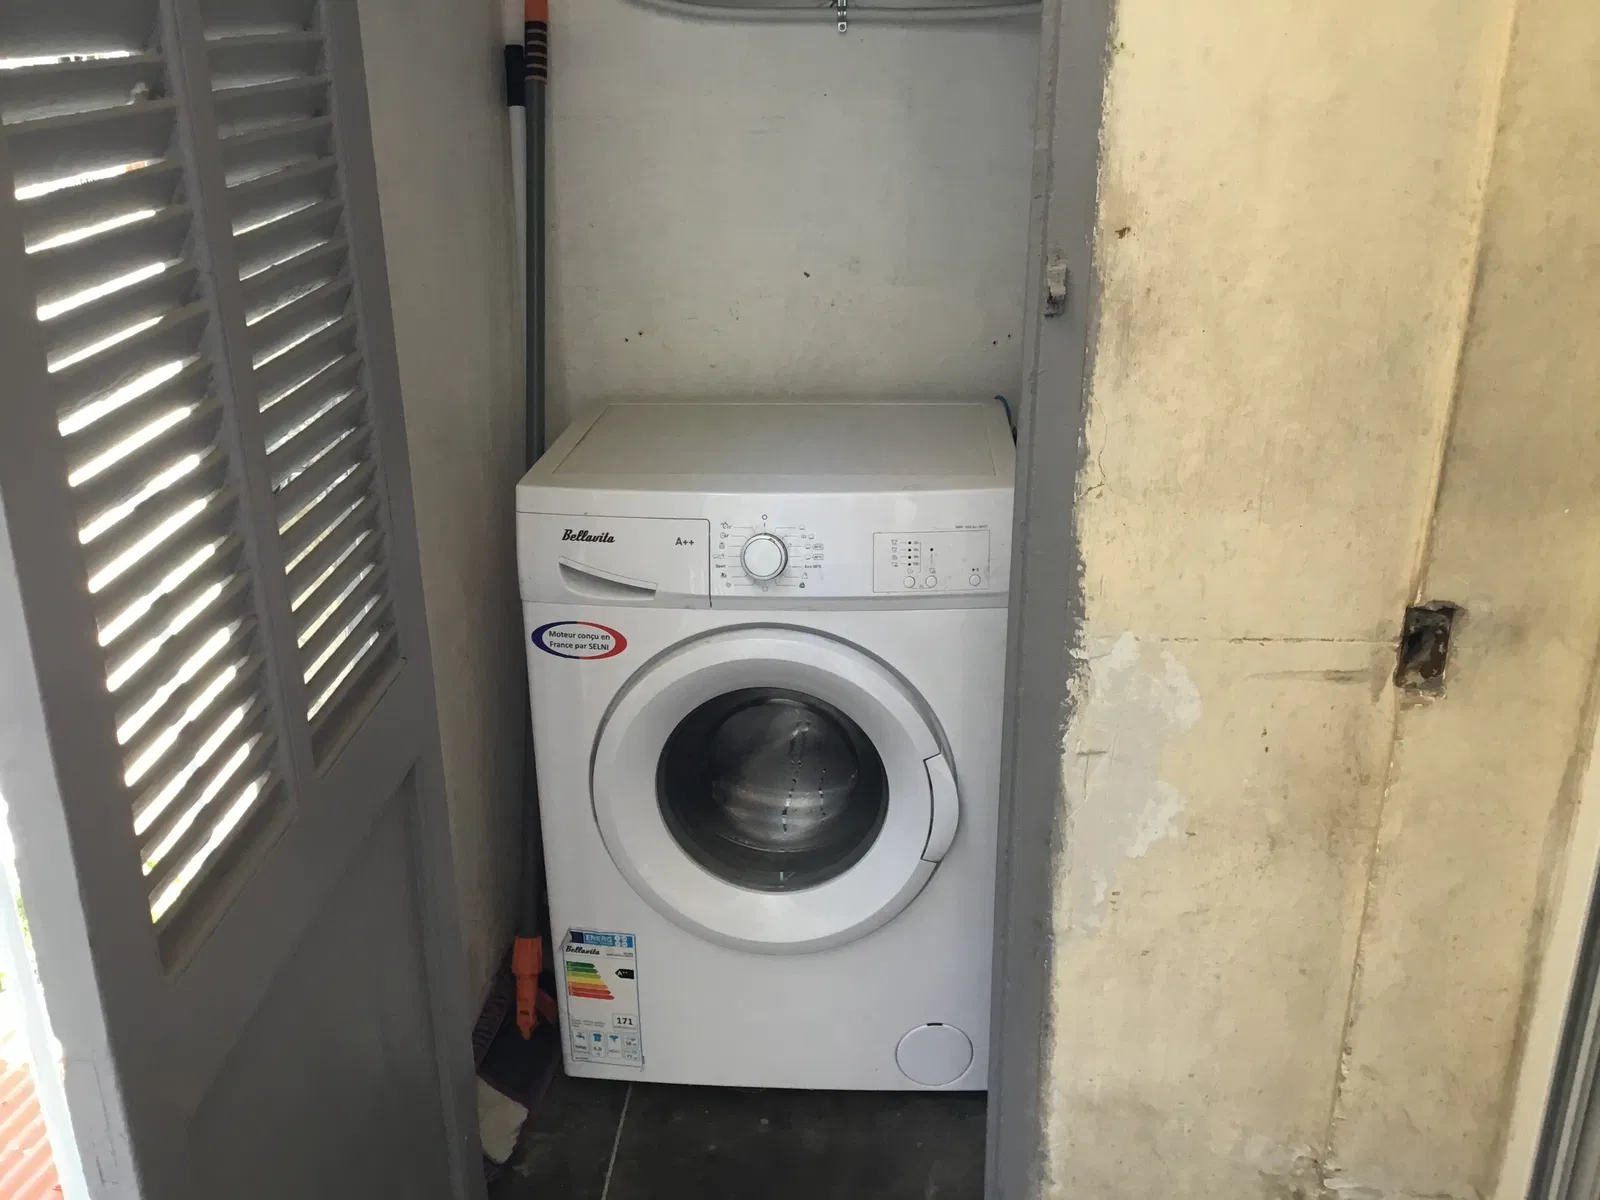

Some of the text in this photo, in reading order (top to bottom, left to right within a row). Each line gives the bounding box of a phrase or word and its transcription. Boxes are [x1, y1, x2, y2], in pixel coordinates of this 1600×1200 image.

[561, 528, 616, 544] Bellavita
[675, 536, 695, 546] A++
[548, 630, 576, 639] Moteur
[577, 633, 599, 641] conçu
[549, 641, 573, 649] France
[588, 643, 609, 651] SELNI
[585, 934, 613, 943] ENERG
[565, 945, 601, 956] Bellavita
[616, 1017, 634, 1026] 171
